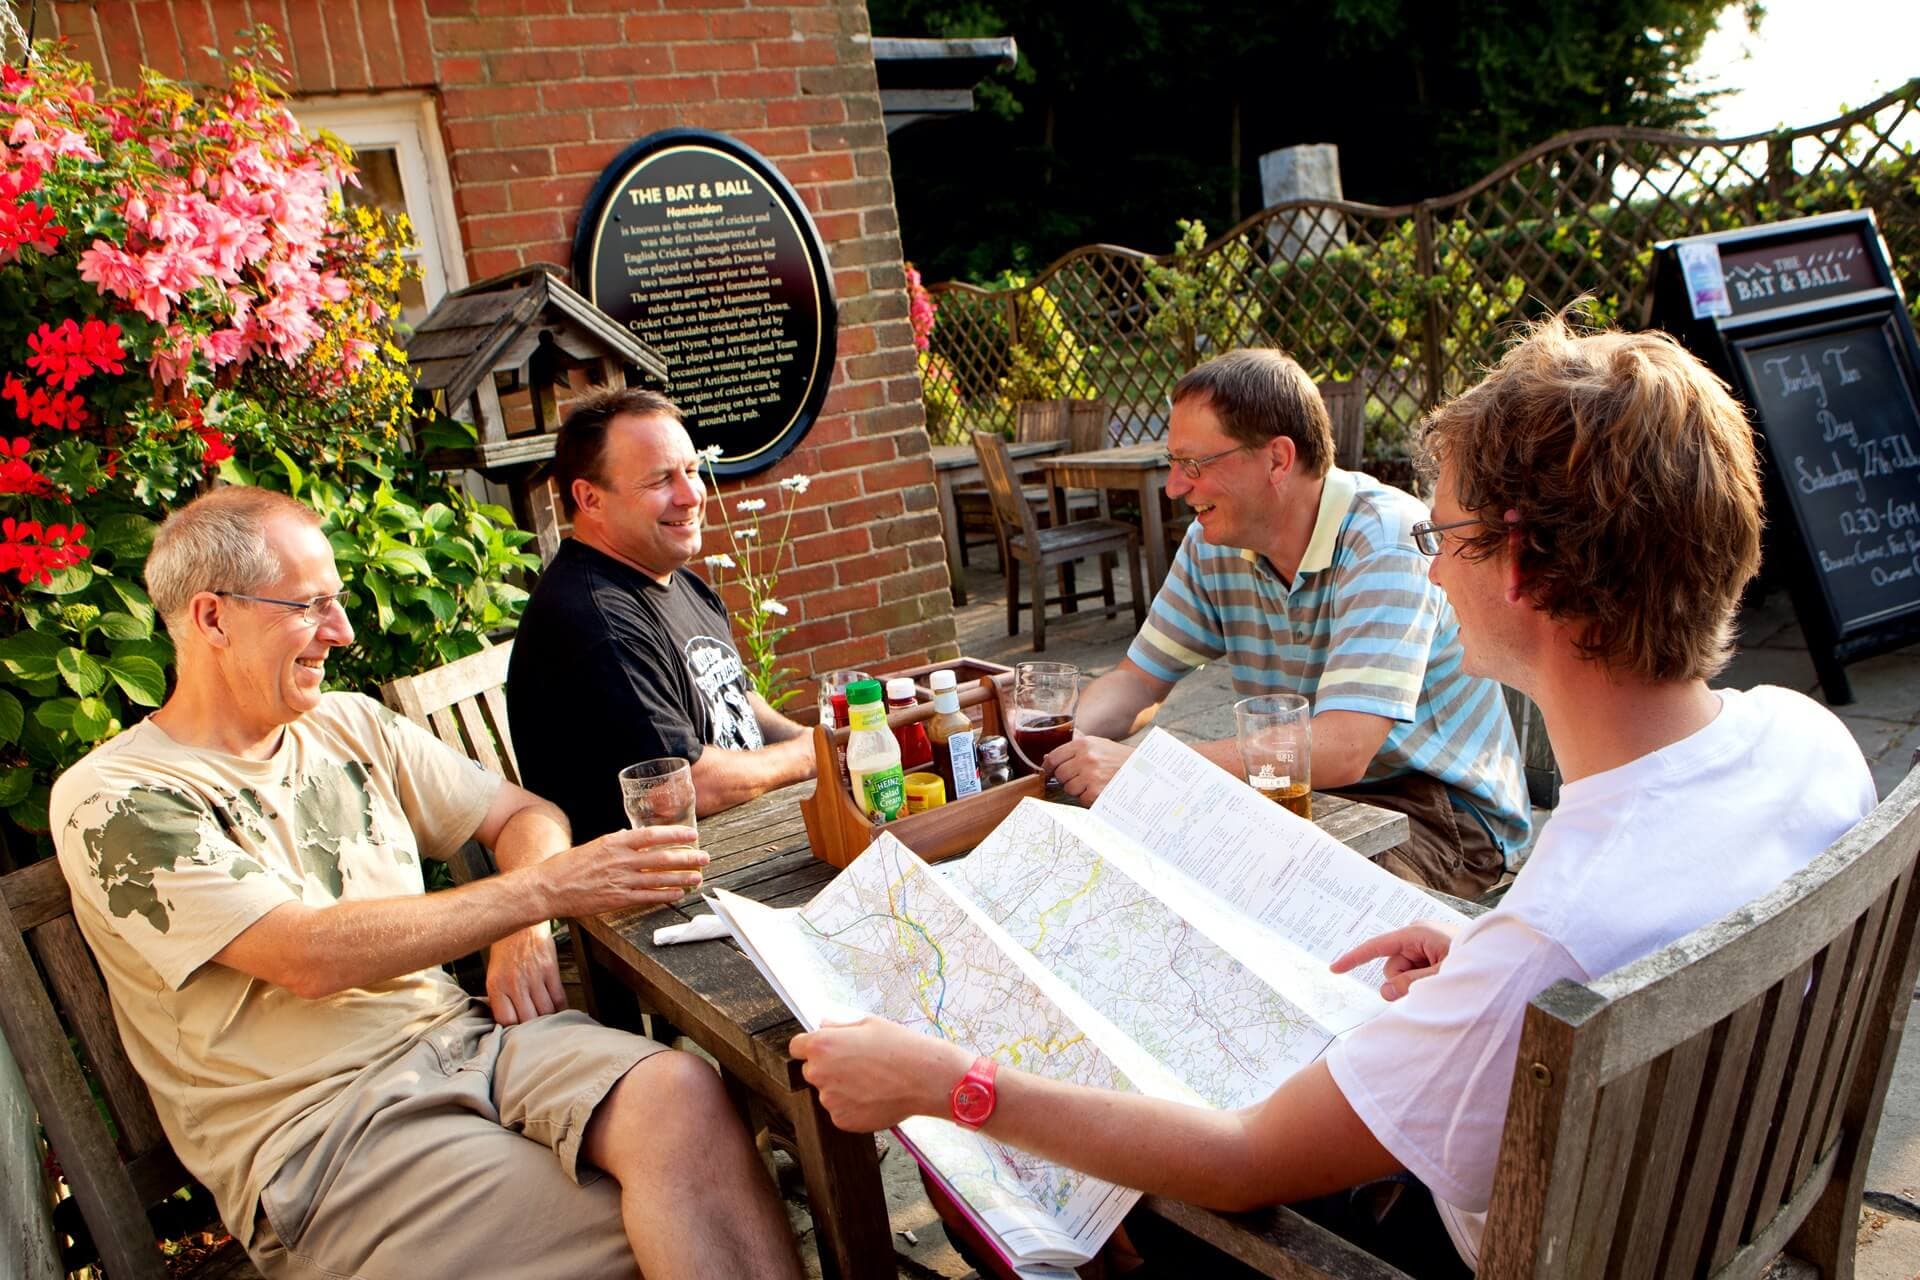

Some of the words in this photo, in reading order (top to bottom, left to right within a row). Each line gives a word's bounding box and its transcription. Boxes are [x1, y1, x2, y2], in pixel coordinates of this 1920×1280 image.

[628, 187, 662, 206] THE
[665, 184, 695, 202] BAT
[699, 182, 712, 199] &
[715, 179, 753, 197] BALL
[666, 202, 723, 218] Hambledon
[621, 225, 630, 236] is
[630, 224, 661, 236] known
[661, 223, 672, 232] as
[672, 220, 687, 231] the
[687, 217, 714, 229] cradle
[714, 215, 726, 226] of
[725, 213, 754, 226] cricket
[755, 211, 771, 222] and
[640, 239, 659, 248] was
[658, 235, 674, 246] the
[674, 233, 693, 245] first
[693, 229, 746, 242] headquarters
[746, 225, 757, 236] of
[623, 250, 658, 264] English
[658, 247, 693, 259] Cricket,
[694, 242, 731, 255] although
[731, 239, 759, 252] cricket
[759, 237, 776, 248] had
[626, 265, 650, 277] been
[650, 261, 680, 276] played
[680, 261, 693, 270] on
[692, 258, 707, 269] the
[707, 255, 733, 268] South
[733, 253, 763, 265] Downs
[763, 250, 777, 261] for
[1773, 256, 1801, 272] THE
[629, 292, 649, 304] The
[649, 288, 683, 301] modern
[683, 286, 707, 299] game
[707, 284, 725, 294] was
[726, 276, 771, 291] formulated
[770, 277, 782, 286] on
[640, 279, 658, 289] two
[658, 272, 694, 286] hundred
[694, 272, 718, 285] years
[718, 268, 740, 281] prior
[740, 267, 750, 277] to
[1736, 275, 1775, 301] BAT
[1778, 272, 1798, 293] &
[1799, 263, 1851, 290] BALL
[648, 303, 670, 315] rules
[670, 300, 698, 312] drawn
[698, 299, 711, 309] up
[710, 296, 721, 308] by
[723, 290, 771, 305] Hambledon
[629, 317, 662, 330] Cricket
[662, 314, 685, 326] Club
[685, 314, 697, 323] on
[697, 304, 763, 321] Broadhalfpenny
[763, 302, 791, 313] Down.
[641, 331, 662, 342] This
[663, 324, 709, 339] formidable
[710, 321, 739, 333] cricket
[739, 317, 758, 329] club
[758, 315, 772, 327] led
[772, 314, 784, 326] by
[652, 341, 680, 353] ichard
[681, 340, 711, 351] Nyren,
[711, 335, 725, 346] the
[725, 329, 760, 344] landlord
[761, 328, 771, 339] of
[771, 327, 785, 337] the
[670, 364, 711, 378] occasions
[712, 359, 746, 371] winning
[746, 359, 758, 367] no
[758, 355, 775, 365] less
[775, 353, 794, 362] than
[686, 350, 714, 366] played
[714, 350, 726, 359] an
[727, 346, 740, 357] All
[741, 341, 775, 355] England
[775, 340, 798, 350] Team
[675, 377, 702, 391] times!
[703, 373, 740, 388] Artifacts
[740, 368, 772, 381] relating
[771, 368, 782, 376] to
[683, 390, 713, 404] origins
[713, 388, 725, 399] of
[724, 384, 753, 397] cricket
[753, 383, 769, 392] can
[769, 380, 780, 389] be
[698, 402, 732, 415] hanging
[732, 400, 744, 408] on
[744, 396, 758, 406] the
[758, 392, 781, 404] walls
[697, 413, 727, 428] around
[727, 411, 741, 422] the
[742, 408, 761, 422] pub.
[1795, 450, 1867, 503] Saturday
[877, 777, 900, 790] HEINZ
[880, 787, 900, 799] Salad
[879, 796, 902, 808] Cream
